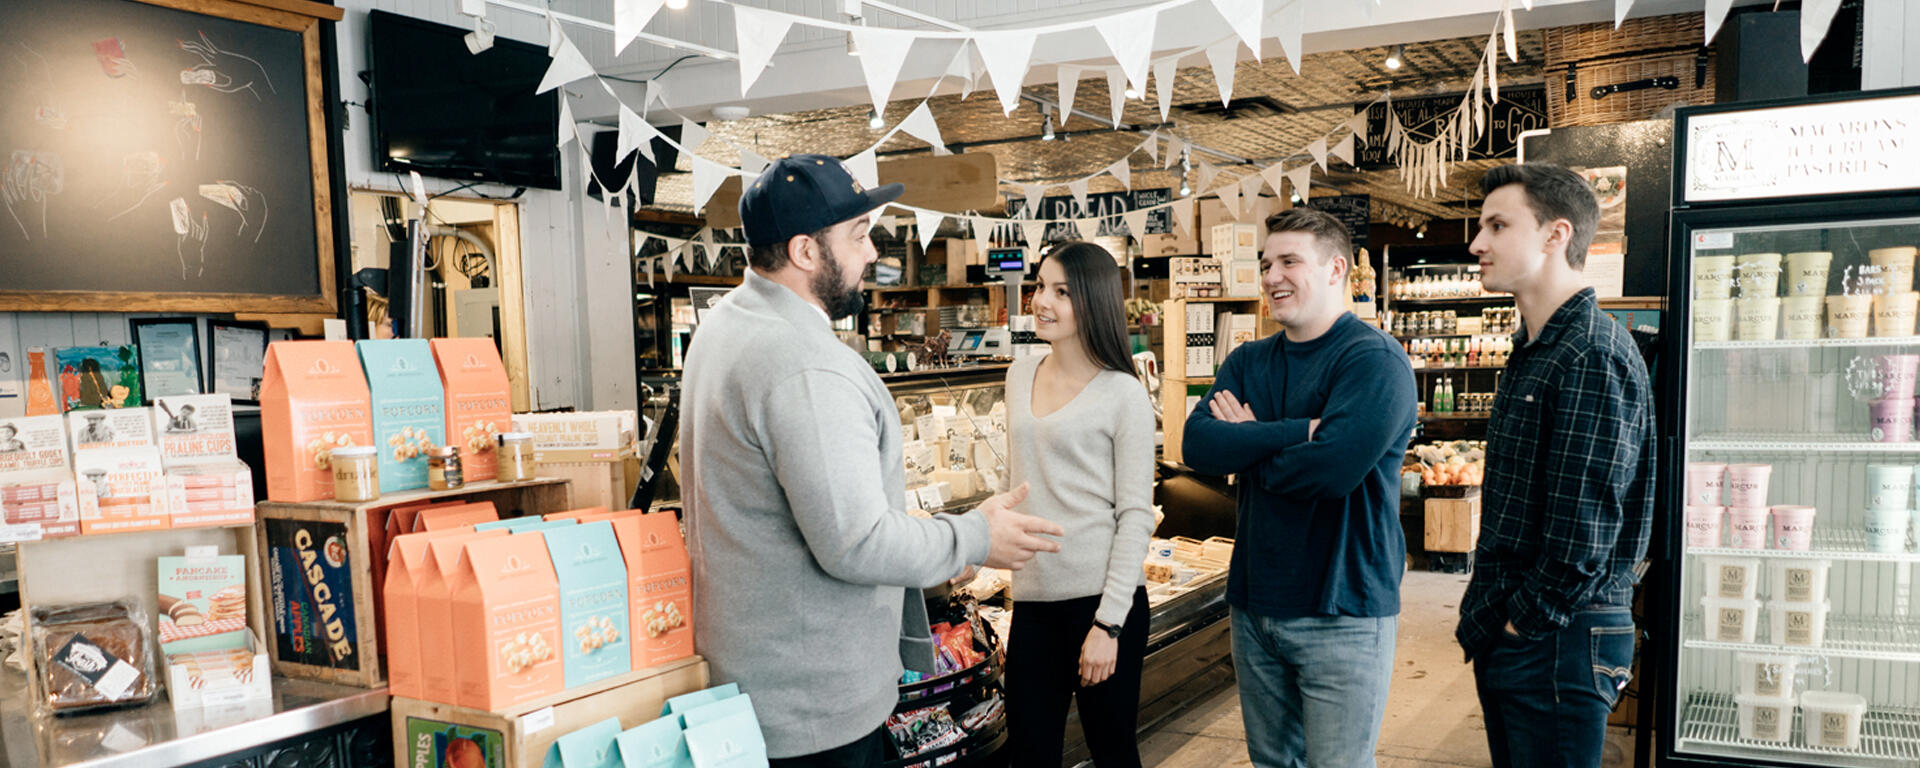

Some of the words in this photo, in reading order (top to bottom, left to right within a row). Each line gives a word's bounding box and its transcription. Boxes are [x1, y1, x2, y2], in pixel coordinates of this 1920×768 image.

[1397, 107, 1440, 127] MEALS
[1435, 97, 1499, 155] RDY
[1493, 119, 1506, 130] TO
[1788, 118, 1907, 137] MACARONS
[1787, 159, 1889, 177] PASTRIES
[1055, 195, 1127, 234] BREAD
[302, 407, 365, 422] POPCORN
[381, 404, 440, 417] POPCORN
[456, 399, 508, 411] POPCORN
[164, 440, 204, 455] PRALINE
[207, 439, 233, 452] CUPS
[175, 567, 228, 576] PANCAKE
[295, 528, 352, 661] CASCADE
[636, 576, 688, 595] POPCORN
[567, 589, 623, 609] POPCORN
[493, 605, 554, 627] POPCORN
[290, 600, 306, 653] APPLES
[300, 601, 313, 655] CANADIAN
